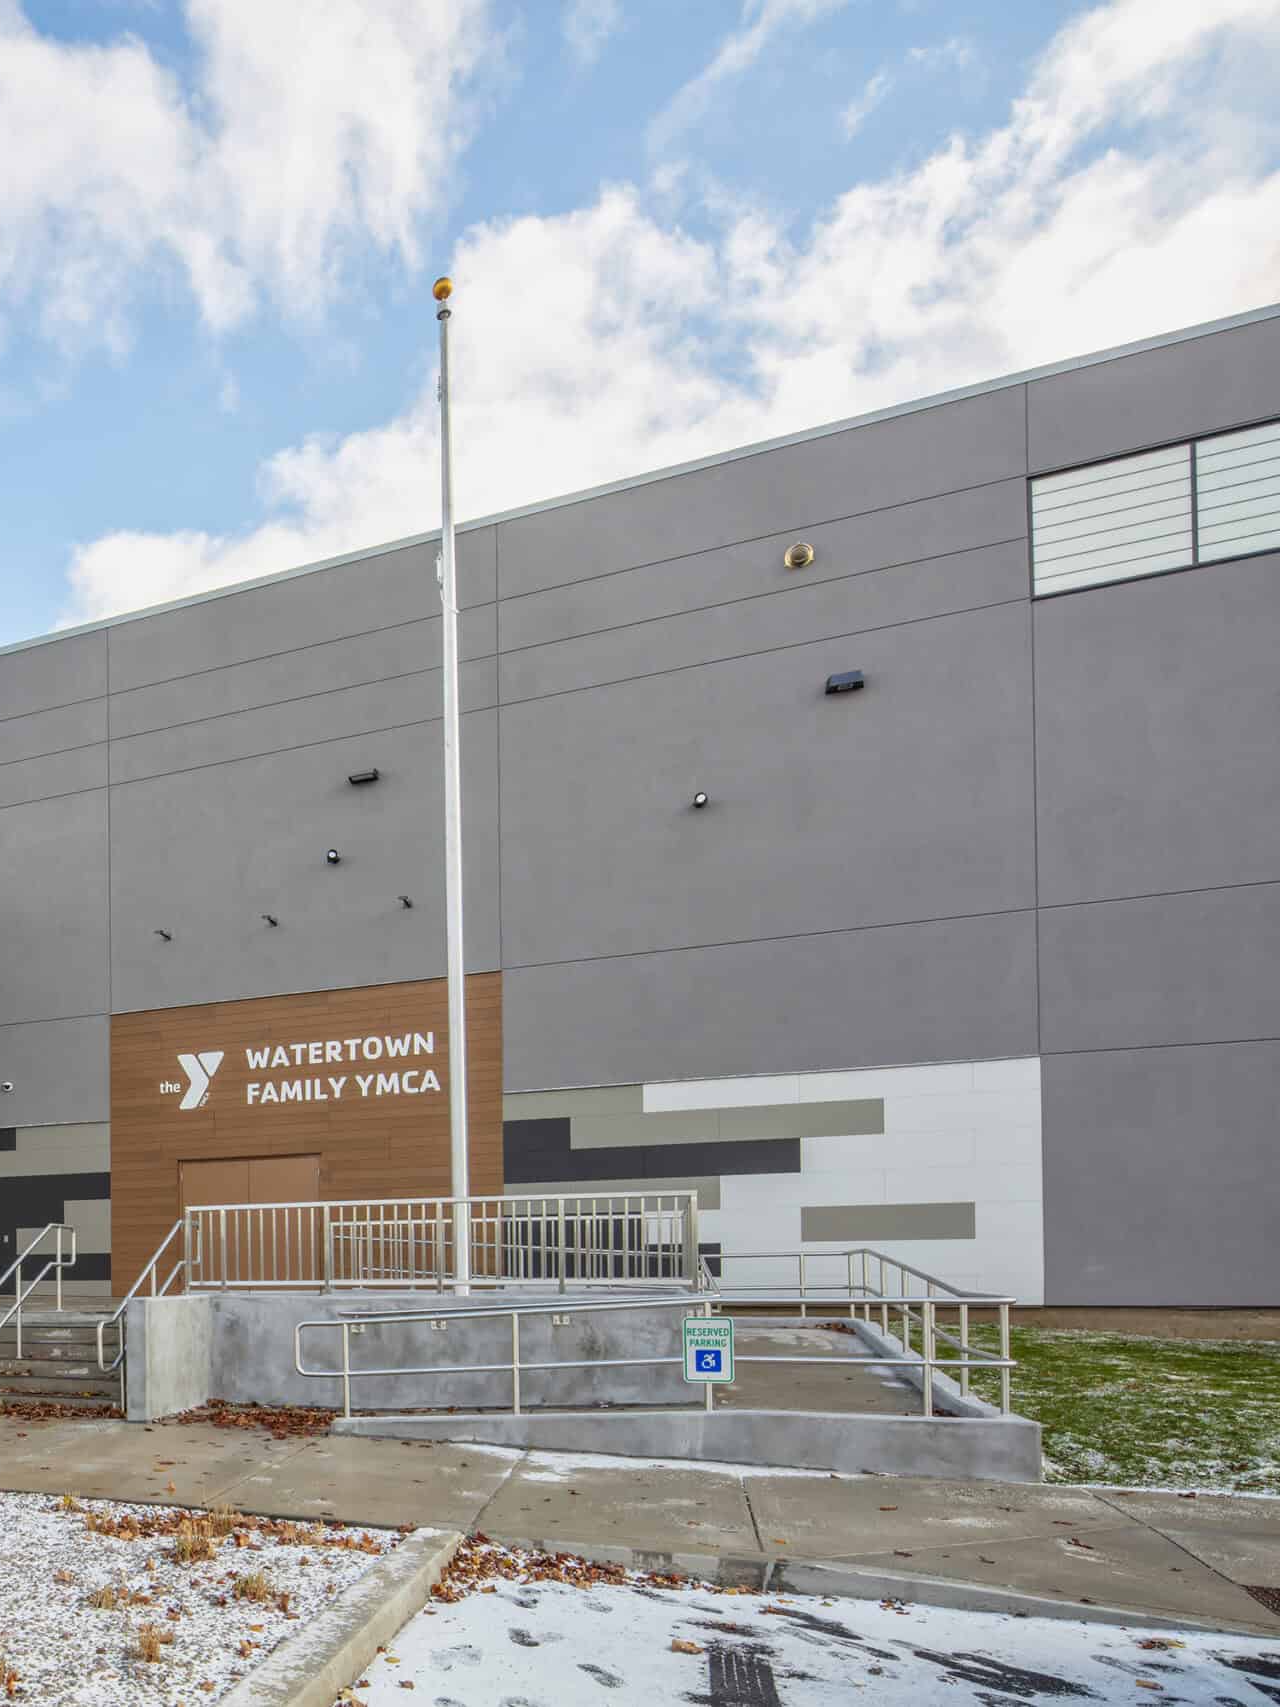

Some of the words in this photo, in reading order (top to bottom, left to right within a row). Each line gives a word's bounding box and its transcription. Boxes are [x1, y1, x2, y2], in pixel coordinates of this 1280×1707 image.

[246, 1031, 434, 1069] WATERTOWN
[159, 1080, 181, 1094] the
[246, 1076, 346, 1105] FAMILY
[355, 1069, 441, 1098] YMCA
[687, 1327, 729, 1337] RESERVED
[689, 1338, 727, 1347] PARKING
